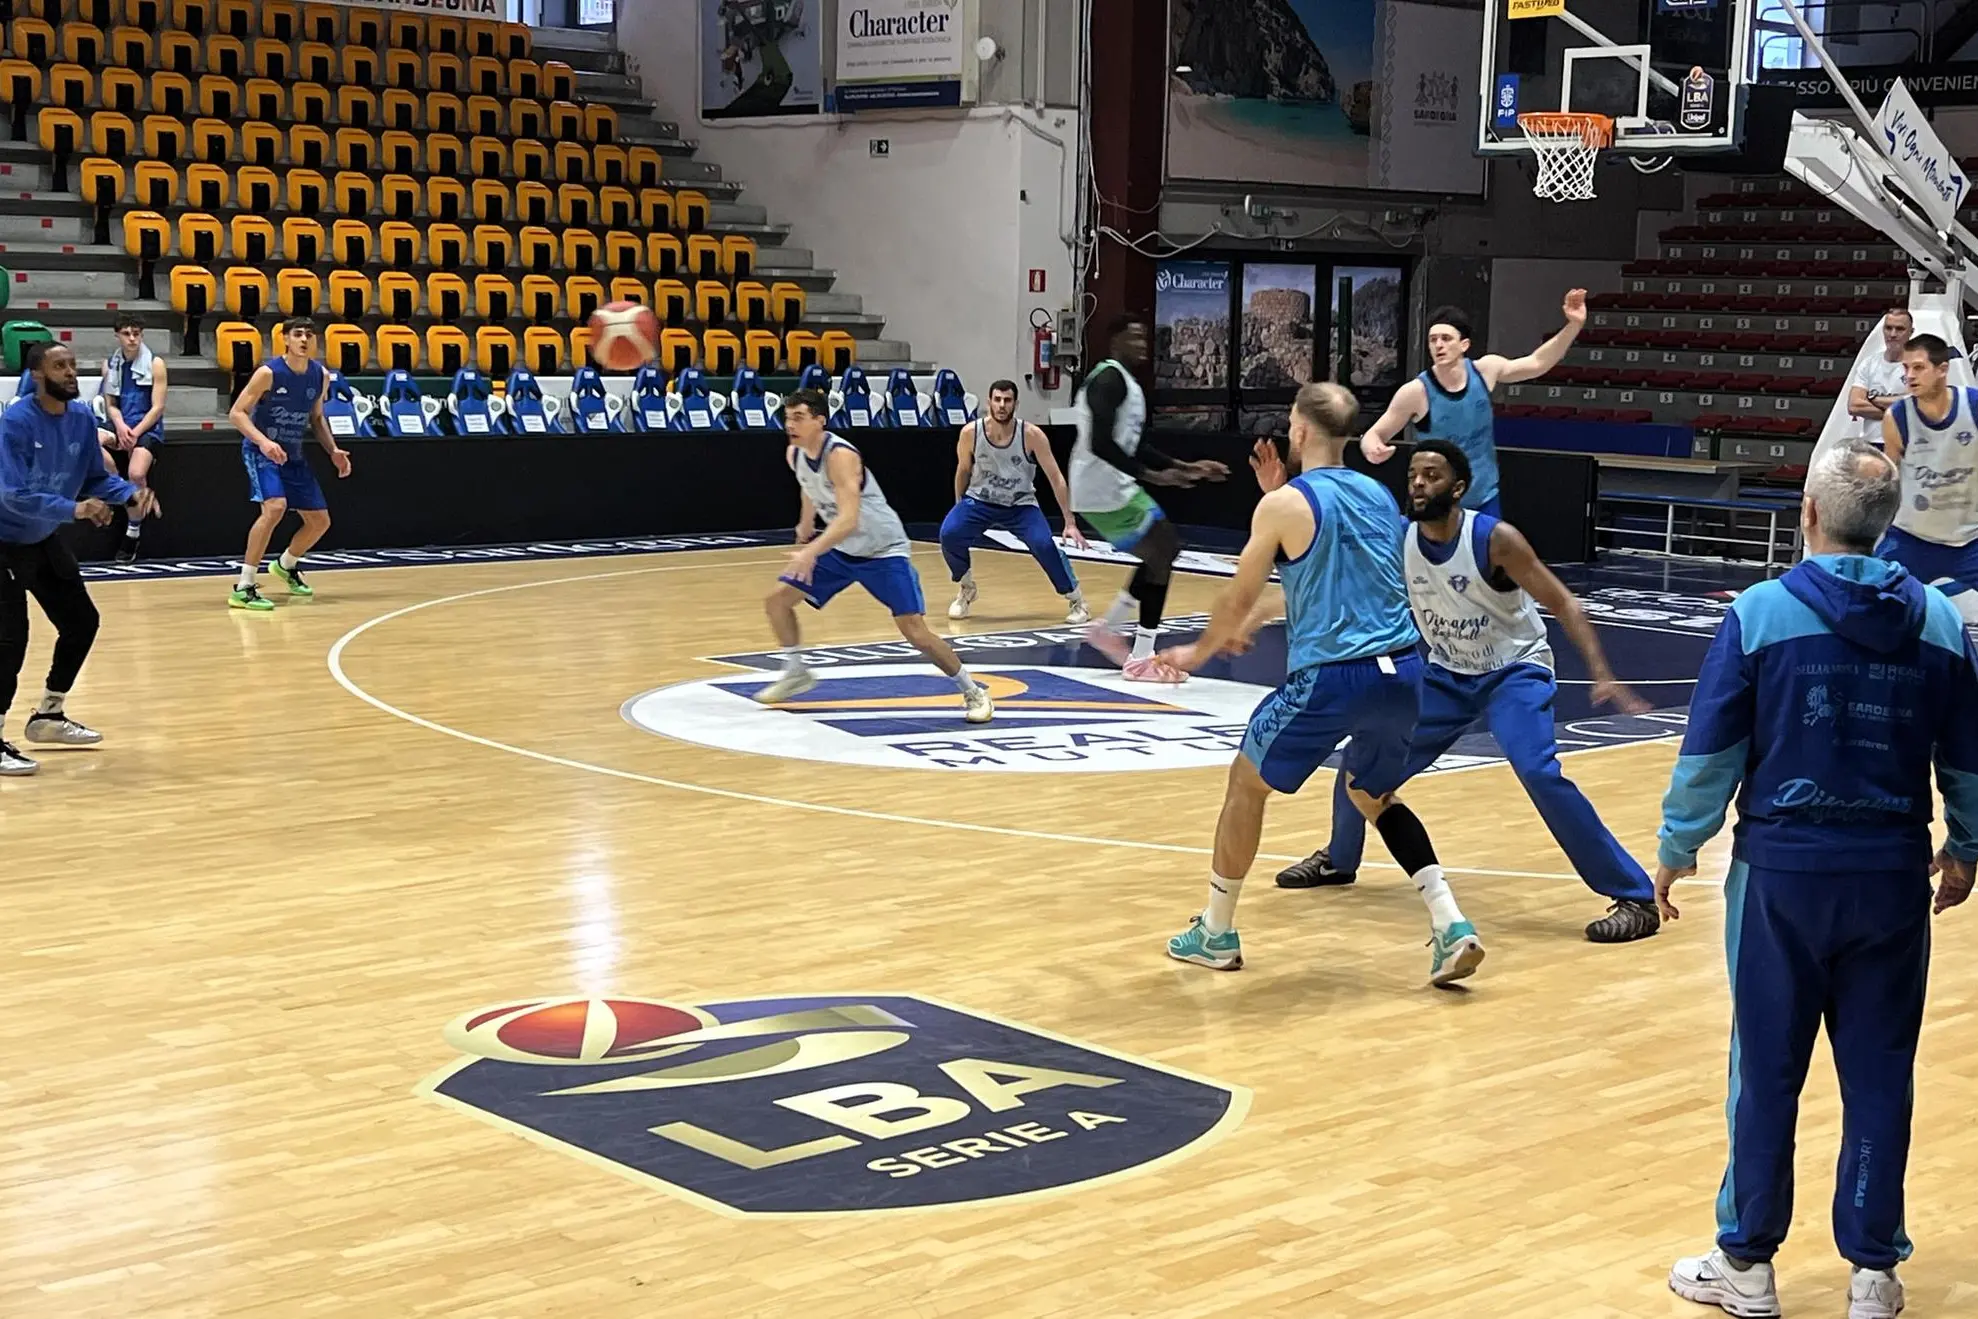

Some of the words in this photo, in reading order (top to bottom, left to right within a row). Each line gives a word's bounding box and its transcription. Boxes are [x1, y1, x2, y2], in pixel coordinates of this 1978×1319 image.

[849, 8, 949, 39] Character
[1497, 109, 1515, 118] FIP
[1172, 273, 1225, 290] Character
[647, 1057, 1127, 1170] LBA
[866, 1121, 1070, 1179] SERIE
[1066, 1109, 1128, 1131] A
